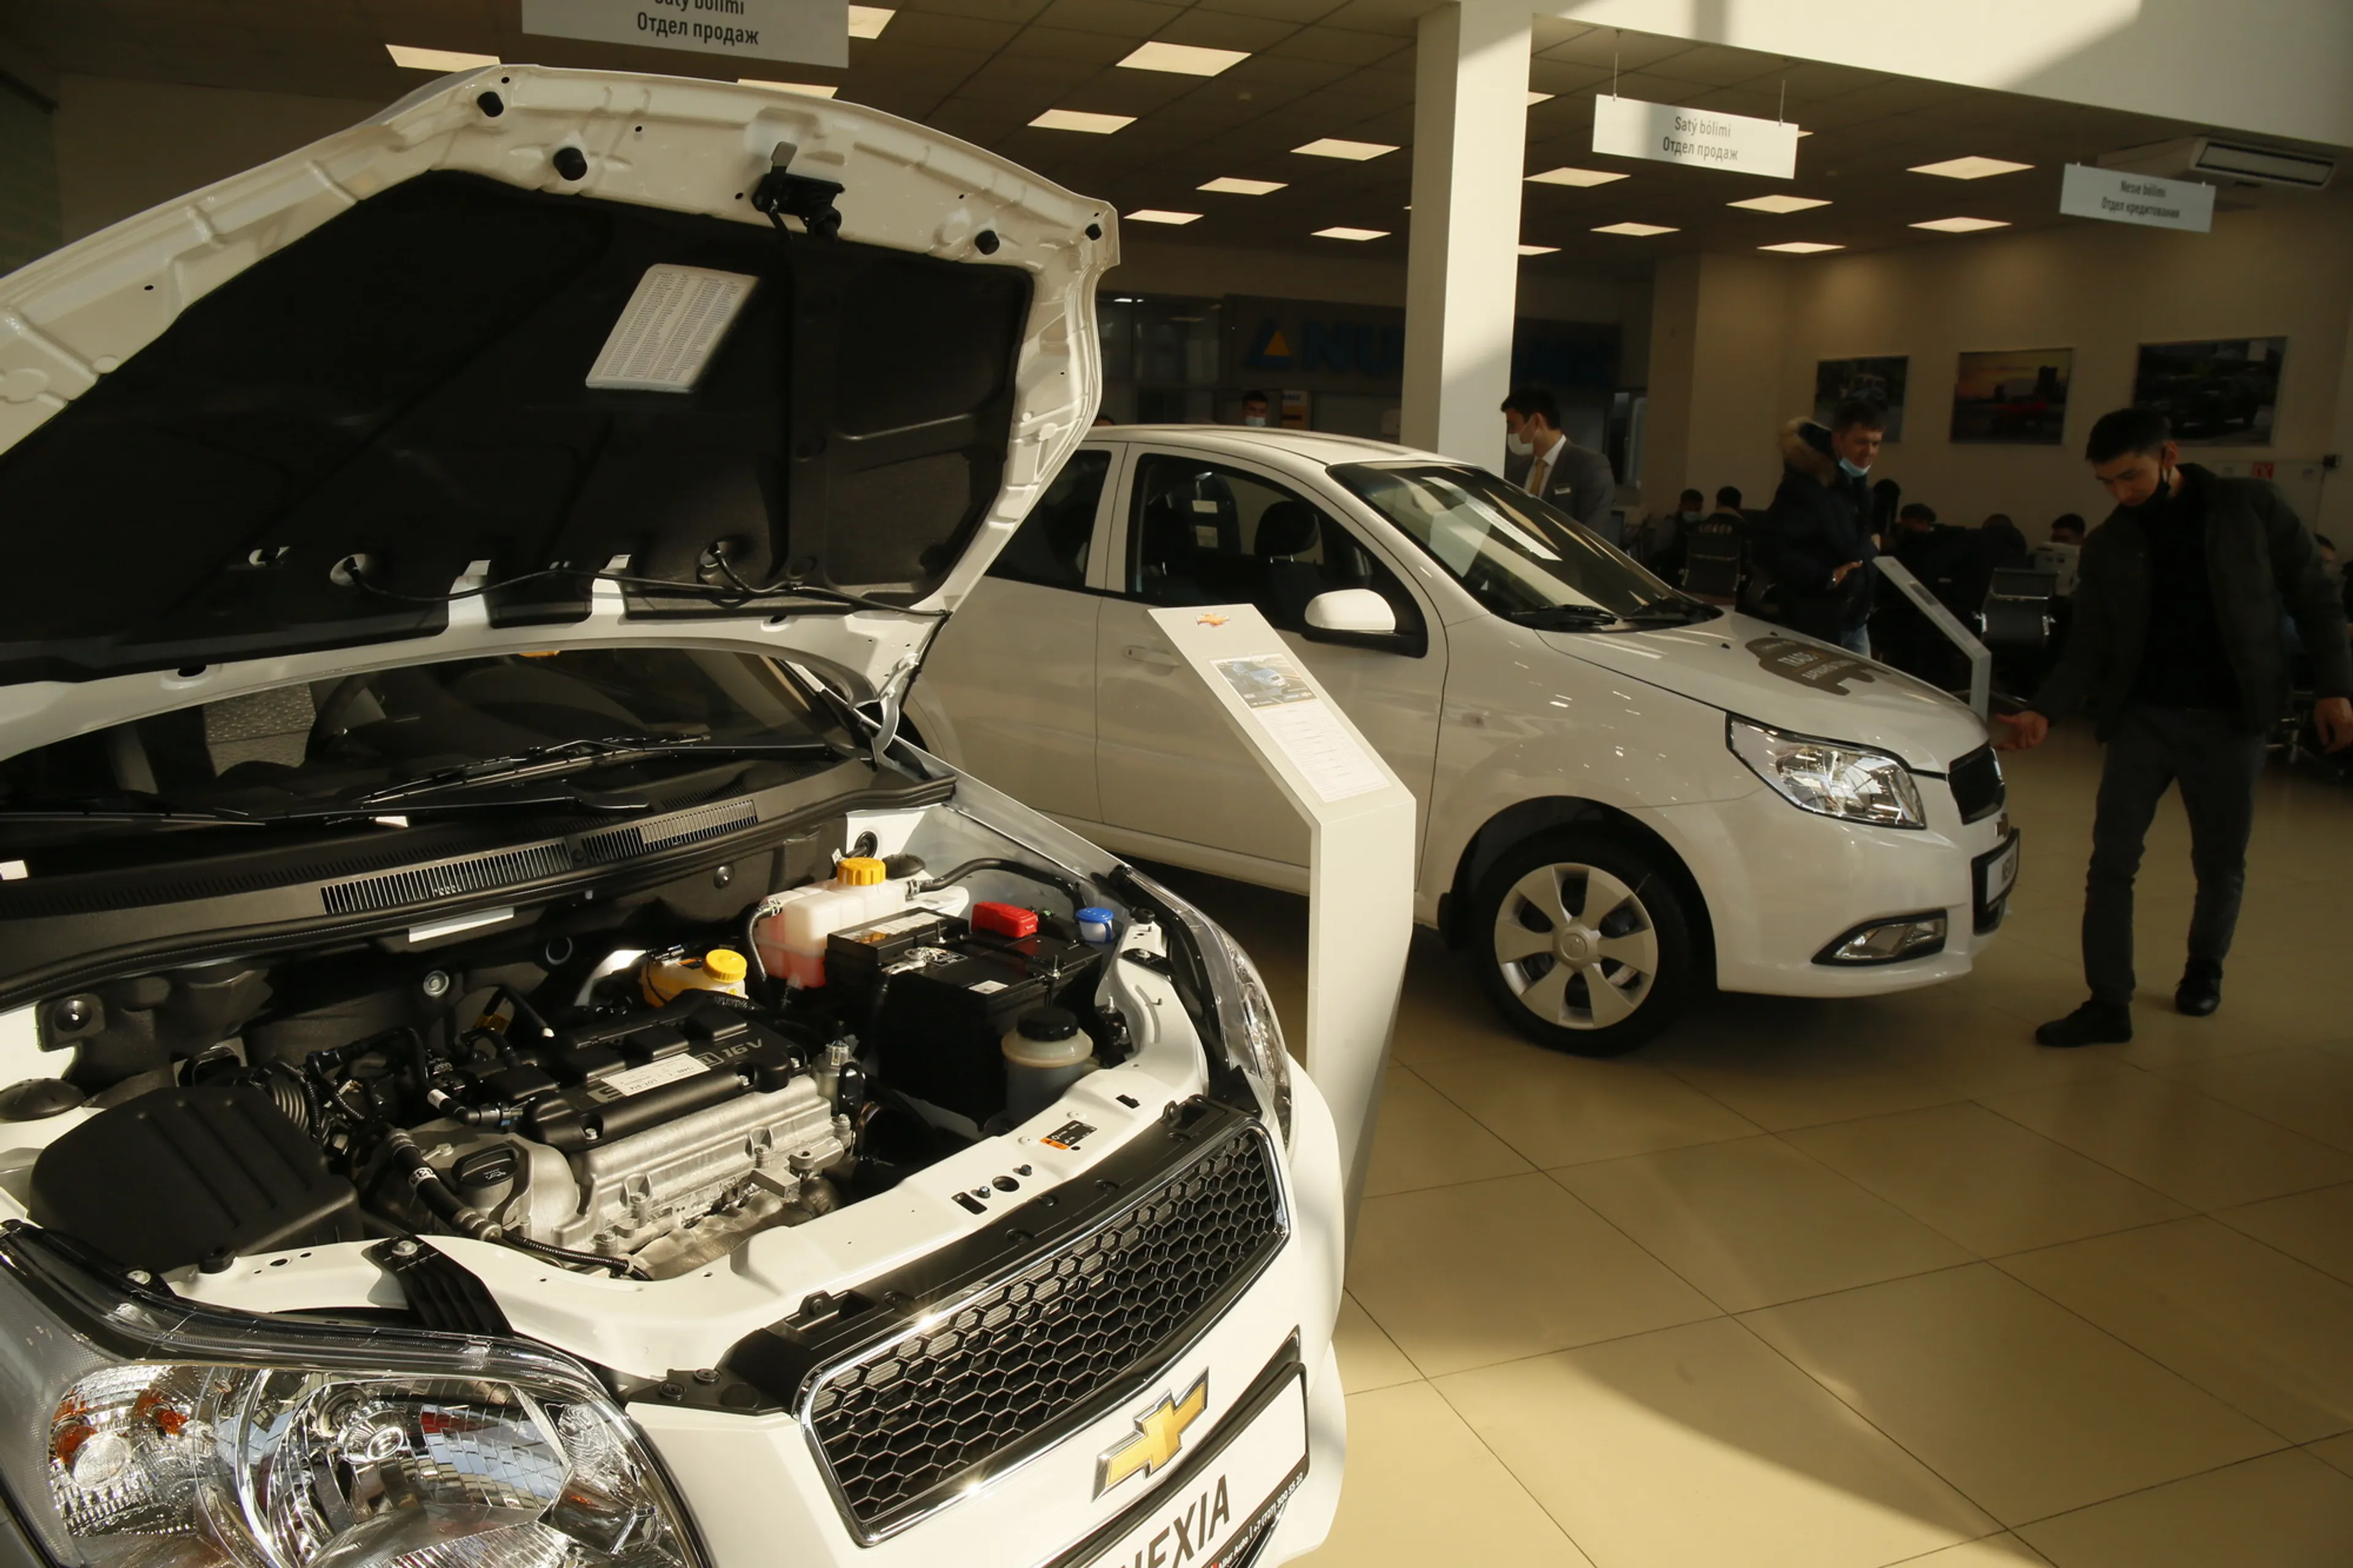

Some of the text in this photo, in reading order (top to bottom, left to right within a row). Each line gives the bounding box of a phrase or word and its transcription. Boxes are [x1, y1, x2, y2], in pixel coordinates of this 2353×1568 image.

[637, 12, 759, 46] Отдел продаж
[1663, 136, 1739, 162] Отдел продаж
[2101, 197, 2124, 213] Отдел
[1233, 1536, 1249, 1556] Auto
